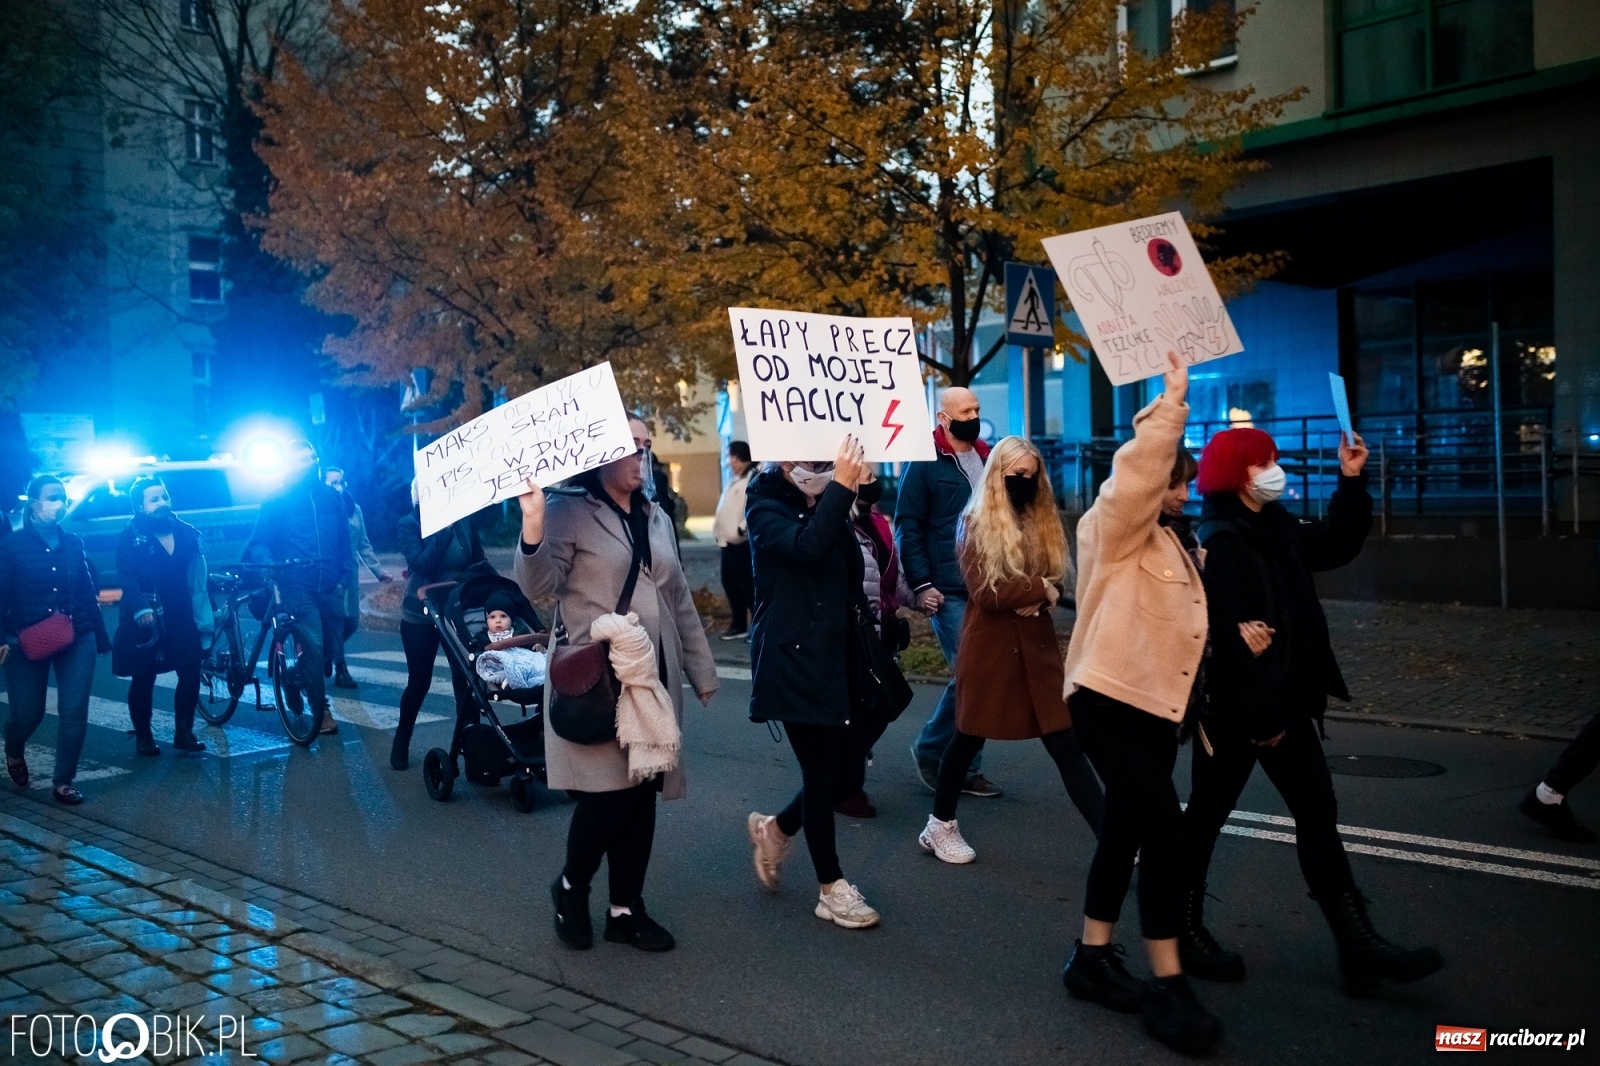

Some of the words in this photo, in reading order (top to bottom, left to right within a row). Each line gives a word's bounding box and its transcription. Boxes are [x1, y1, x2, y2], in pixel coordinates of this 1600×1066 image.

[1129, 218, 1180, 244] BĘDZIEMY
[740, 318, 809, 350] ŁAPY
[830, 324, 912, 355] PRECZ
[1096, 314, 1138, 336] KOBIETA
[752, 354, 789, 382] OD
[808, 353, 896, 390] MOJEJ
[511, 398, 579, 436] SRAM
[761, 387, 865, 425] MACICY
[426, 418, 489, 467] MARS
[503, 401, 531, 420] OD
[437, 462, 473, 488] PIS
[503, 448, 524, 469] W
